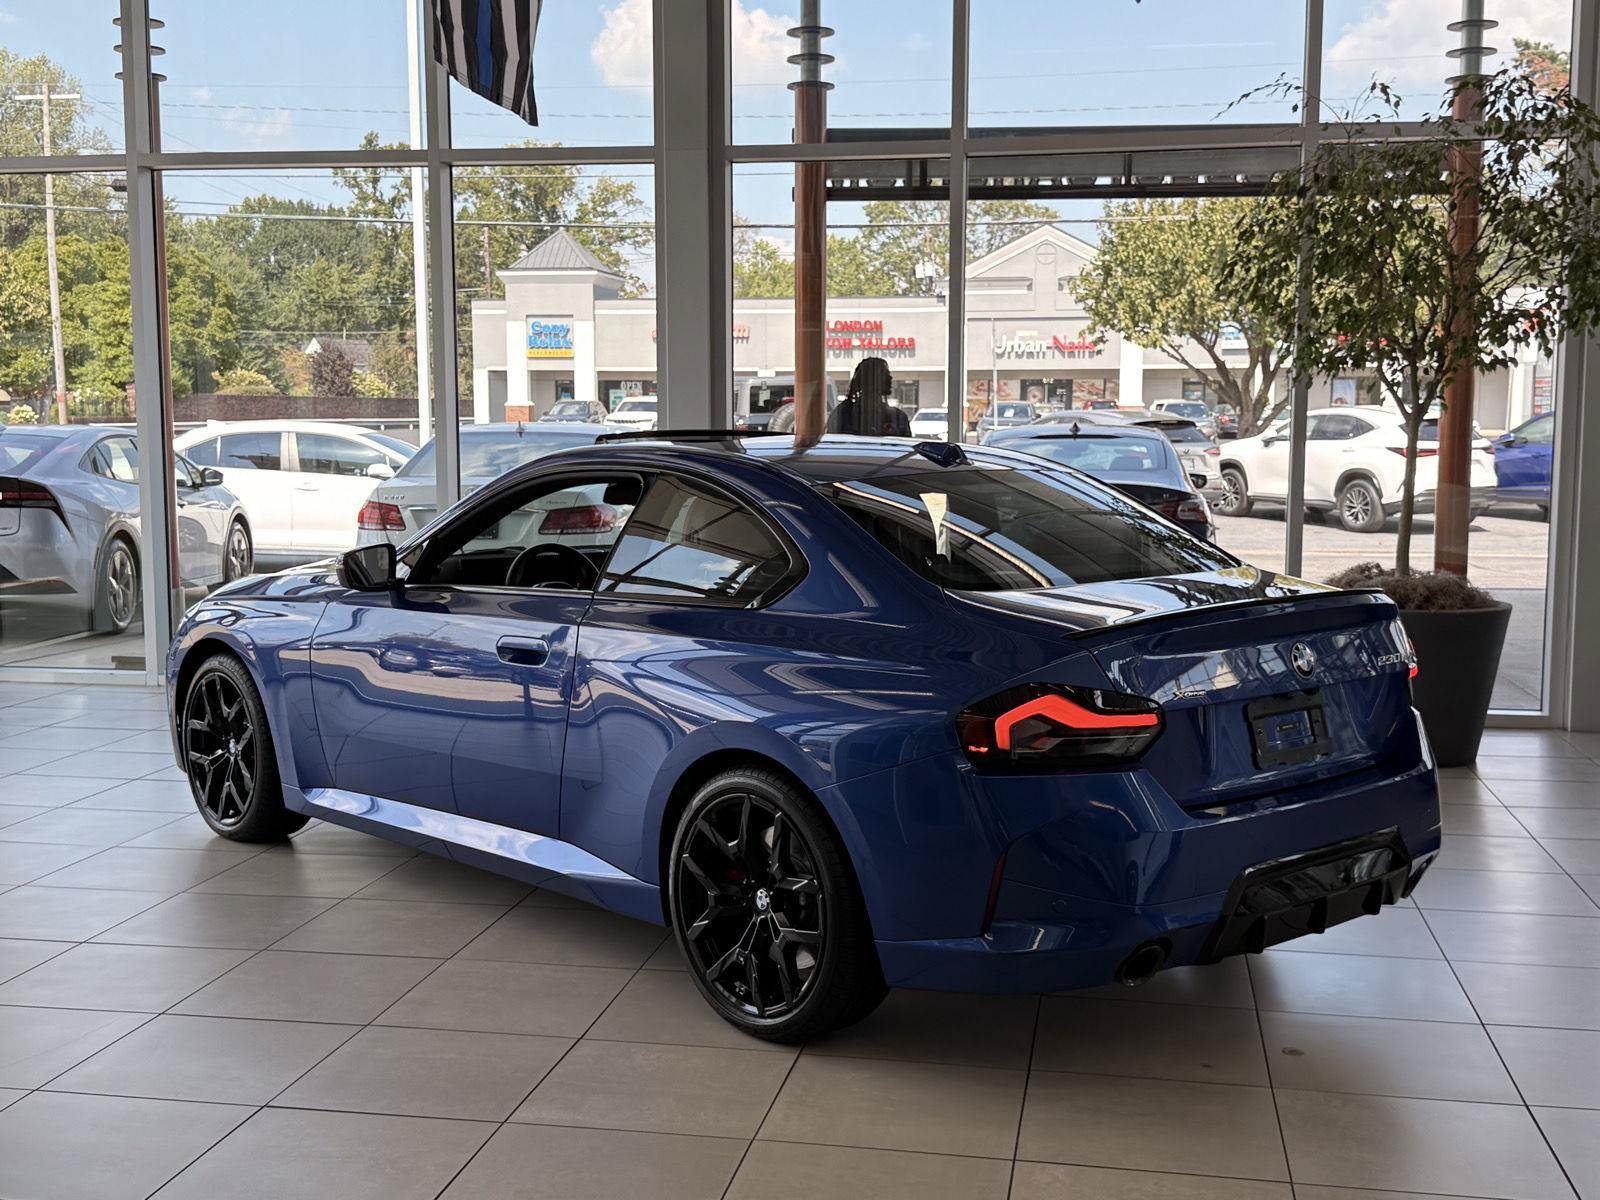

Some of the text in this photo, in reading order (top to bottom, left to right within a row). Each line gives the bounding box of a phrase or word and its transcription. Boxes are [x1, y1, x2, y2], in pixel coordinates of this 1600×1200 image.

[531, 320, 569, 337] Cozy
[825, 320, 883, 332] LONDON
[528, 334, 573, 348] Relax
[860, 337, 915, 350] TAILORS
[994, 334, 1097, 354] Urban Nails
